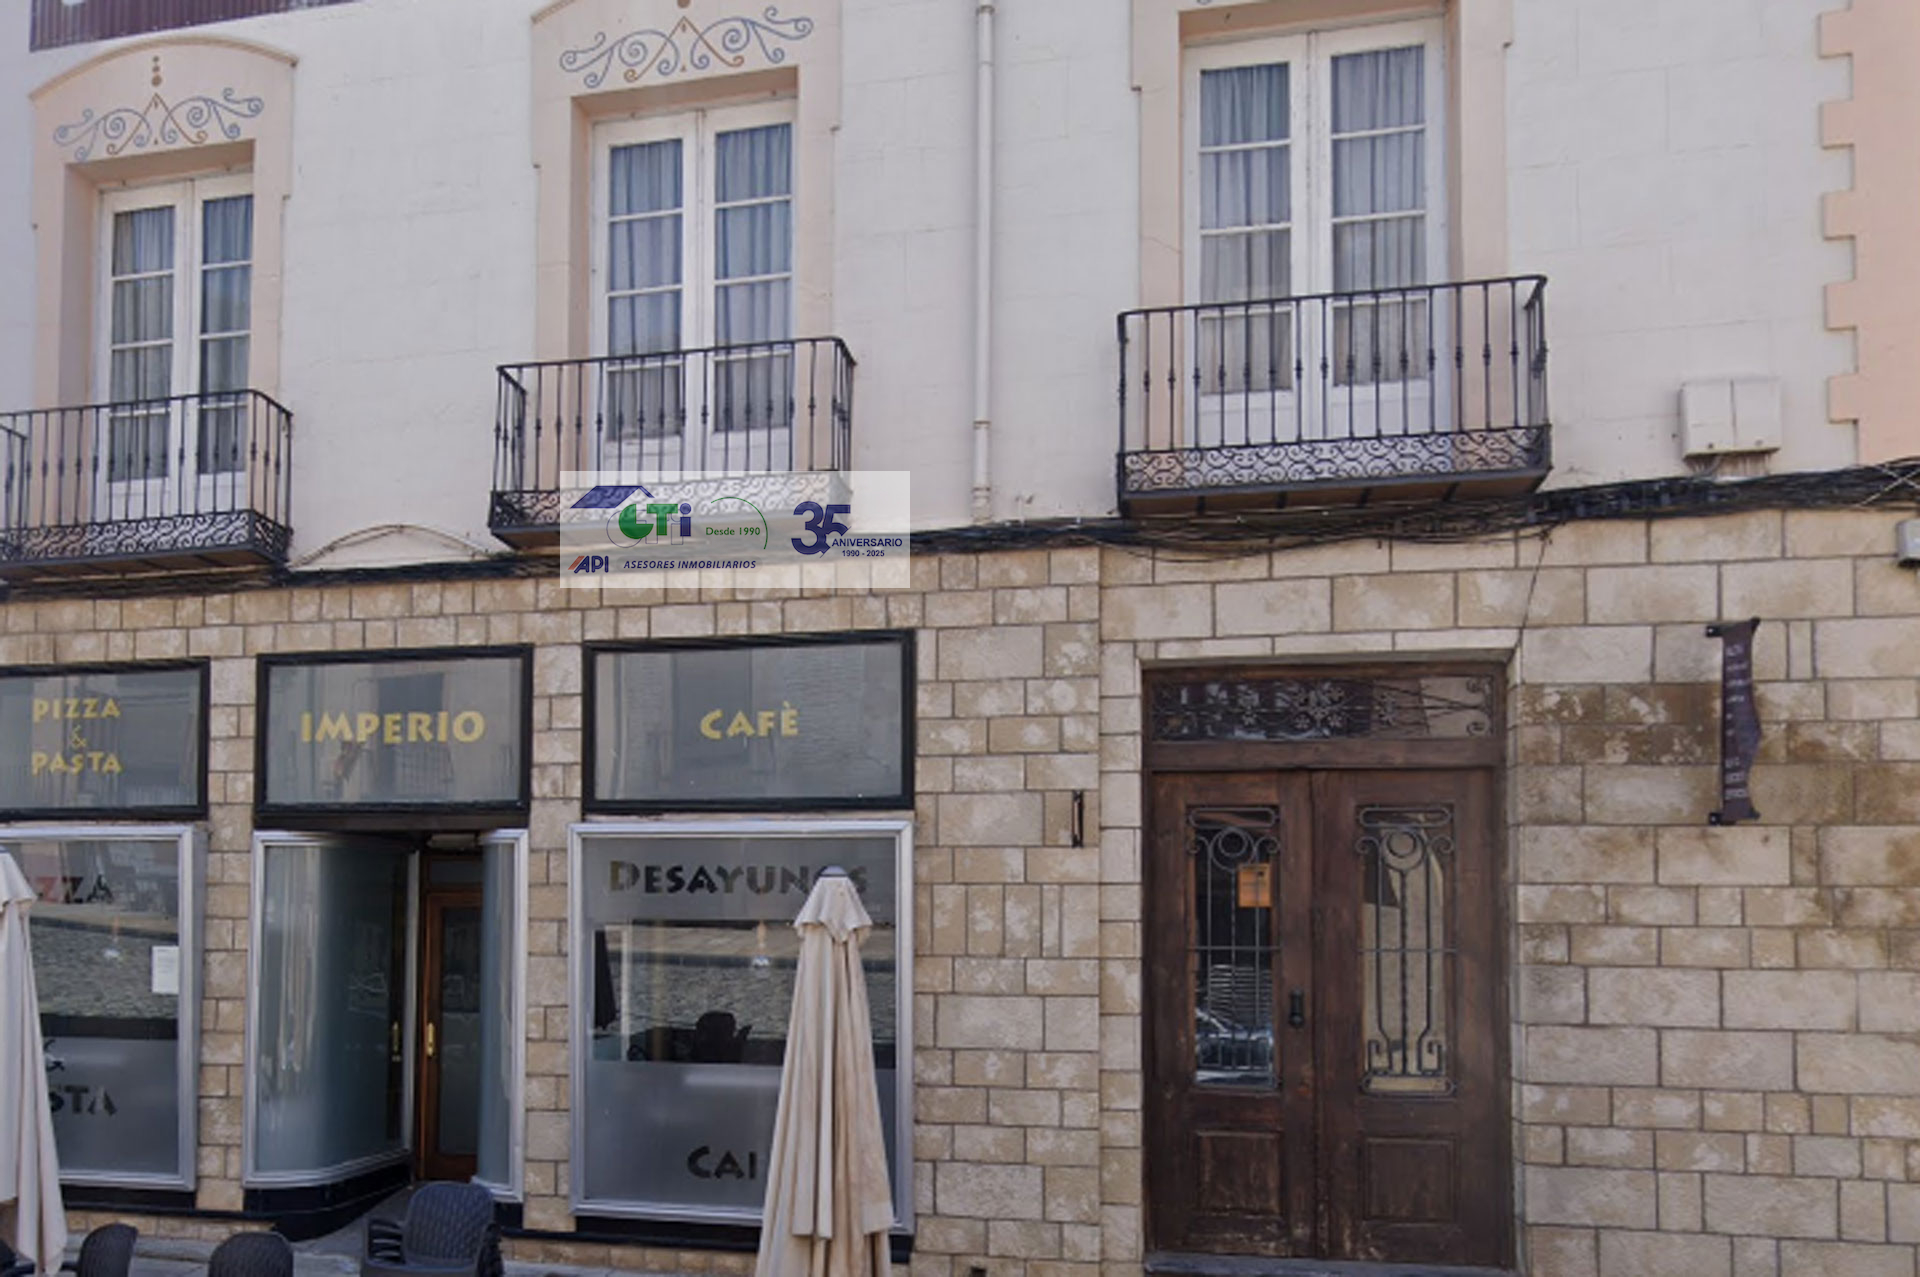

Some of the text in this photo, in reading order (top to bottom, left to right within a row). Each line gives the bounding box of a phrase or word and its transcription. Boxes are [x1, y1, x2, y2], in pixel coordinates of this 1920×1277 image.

[32, 697, 121, 723] PIZZA
[70, 724, 87, 750] &
[301, 710, 485, 743] IMPERIO
[31, 751, 124, 776] PASTA
[35, 873, 114, 904] ZZA
[609, 860, 868, 894] DESAYUNS
[48, 1085, 118, 1116] STA
